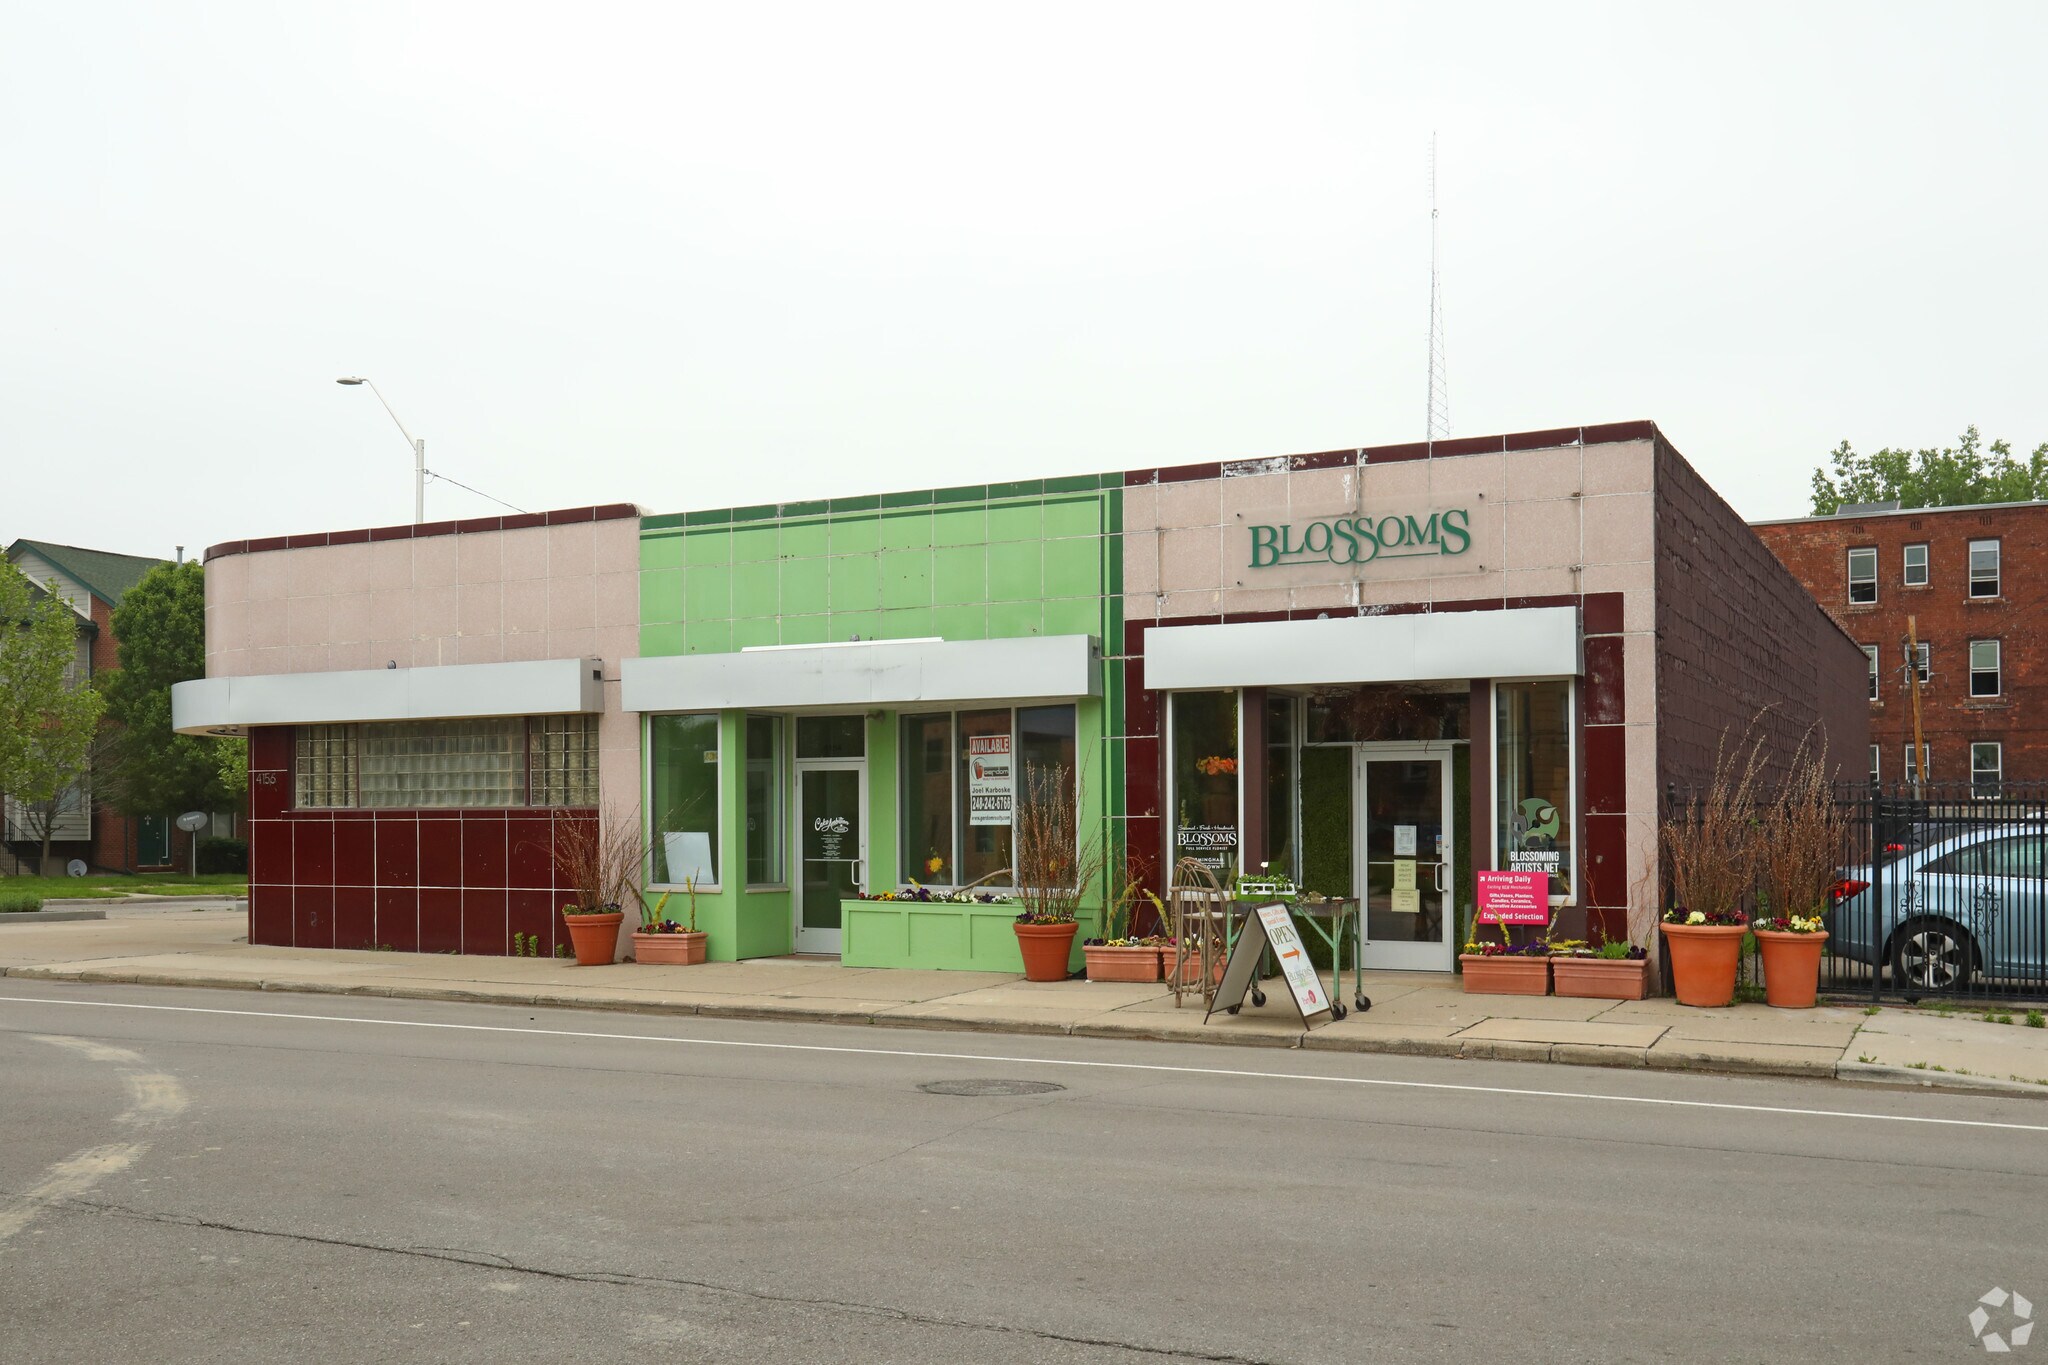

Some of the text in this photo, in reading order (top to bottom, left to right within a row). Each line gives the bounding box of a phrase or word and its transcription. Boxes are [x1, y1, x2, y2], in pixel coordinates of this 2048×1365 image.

[1248, 509, 1471, 568] BLOSSOMS
[971, 738, 1009, 754] AVAILABLE
[256, 773, 277, 785] 4156
[986, 786, 1011, 794] Karboske
[1177, 832, 1237, 847] BLOSSOMS
[1510, 851, 1560, 862] BLOSSOMING
[1510, 862, 1560, 873] ARTISTS.NET
[1487, 875, 1531, 884] Arriving Daily
[1515, 912, 1544, 920] Selection
[1269, 925, 1297, 946] OPEN
